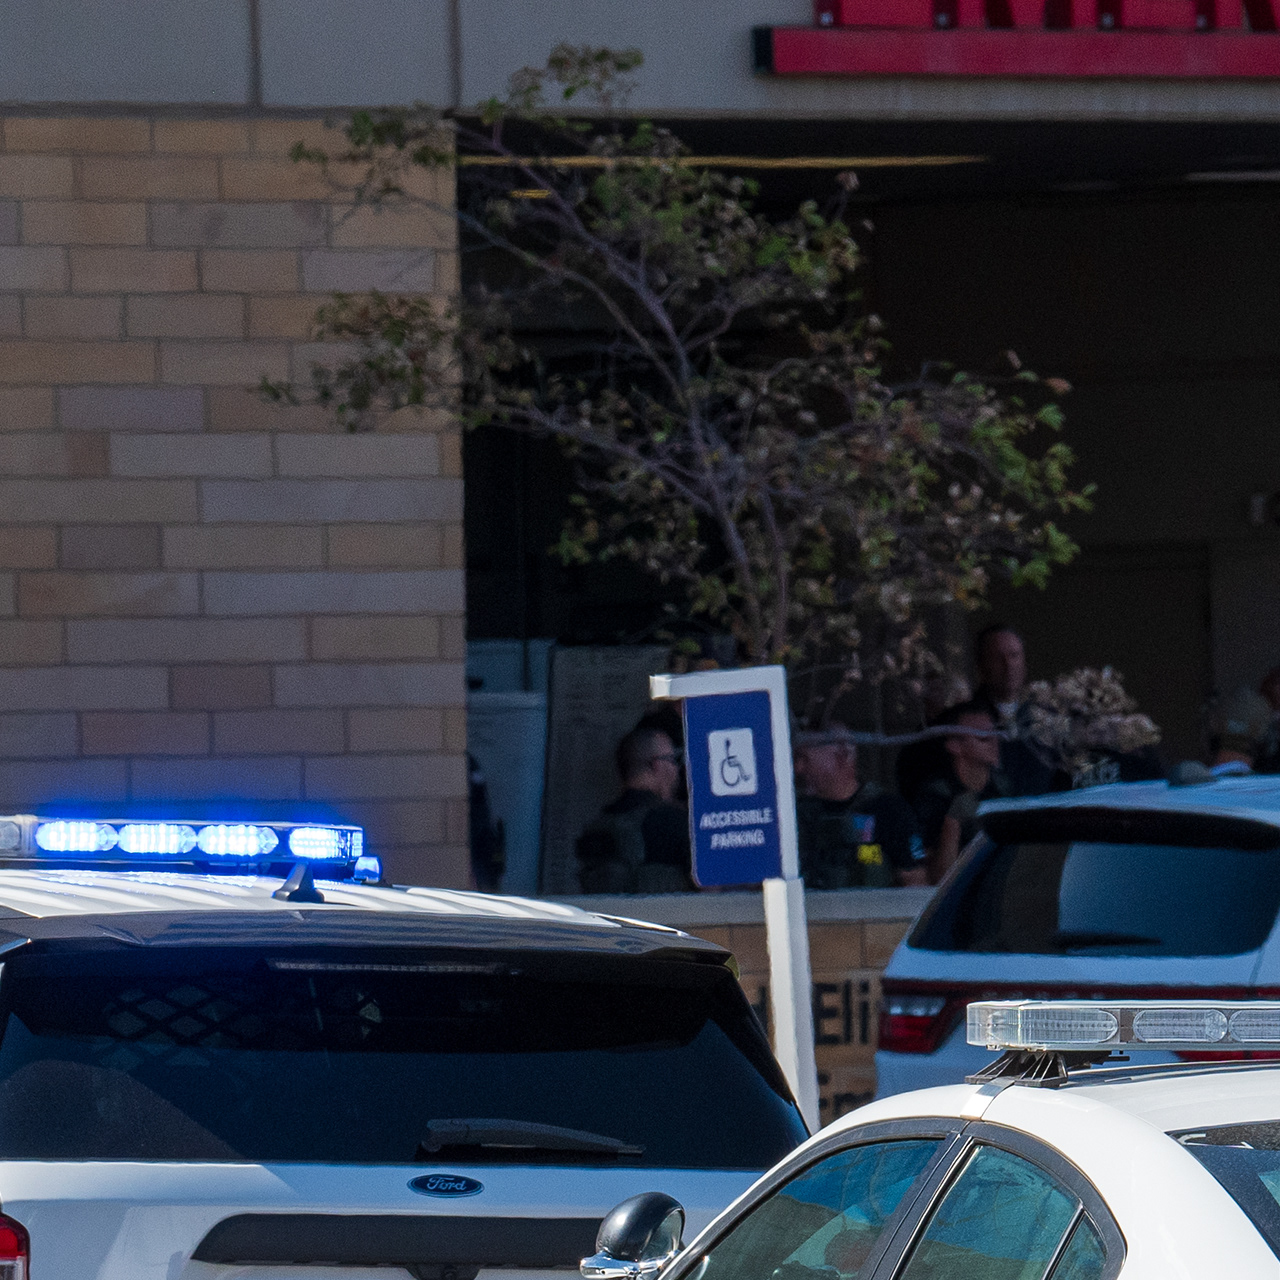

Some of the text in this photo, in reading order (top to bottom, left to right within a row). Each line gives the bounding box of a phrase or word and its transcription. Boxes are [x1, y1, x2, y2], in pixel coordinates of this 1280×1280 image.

[699, 807, 774, 830] ACCESSIBLE
[710, 828, 766, 850] PARKING
[426, 1176, 467, 1191] Ford
